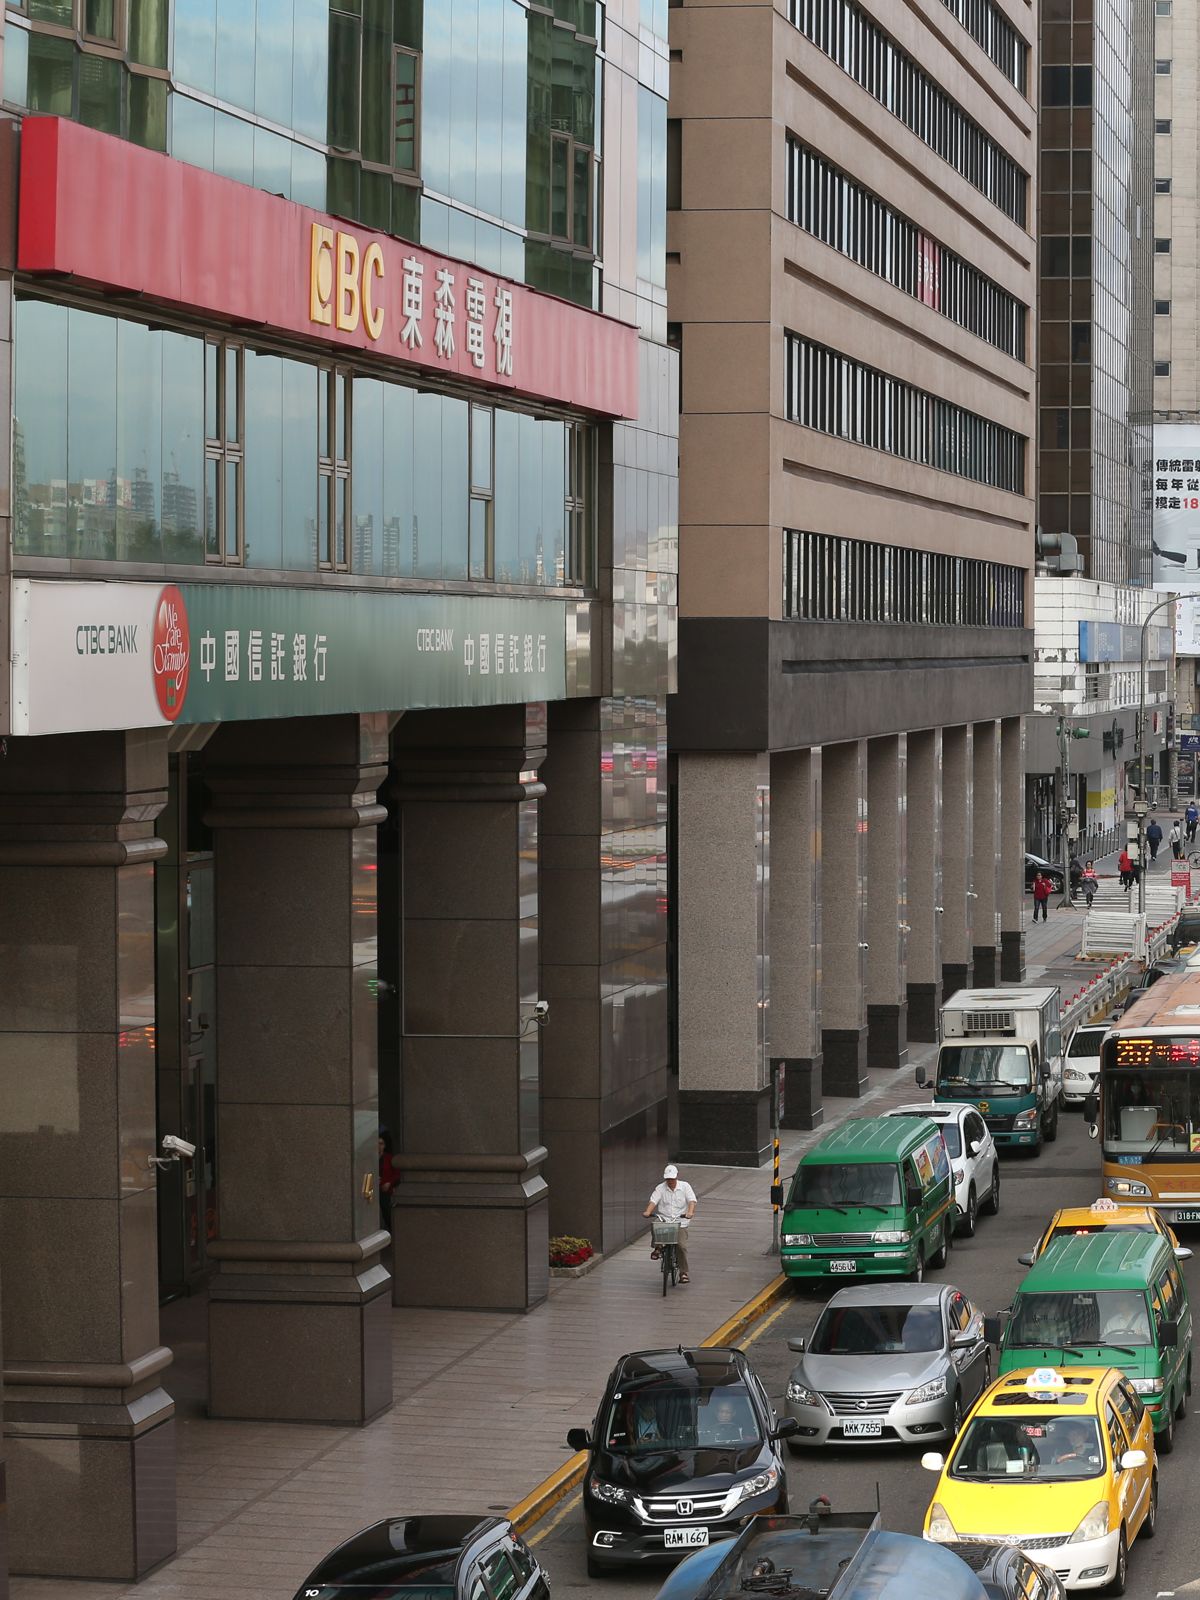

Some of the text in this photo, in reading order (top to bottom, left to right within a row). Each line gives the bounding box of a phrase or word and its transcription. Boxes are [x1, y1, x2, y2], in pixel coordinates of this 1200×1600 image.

[400, 255, 514, 377] 東森電視
[76, 624, 138, 655] CTBC BANK
[199, 630, 328, 683] 中國信託銀行
[416, 628, 454, 651] CTBC BANK
[463, 633, 547, 676] 中國信託銀行
[305, 1589, 320, 1597] 10
